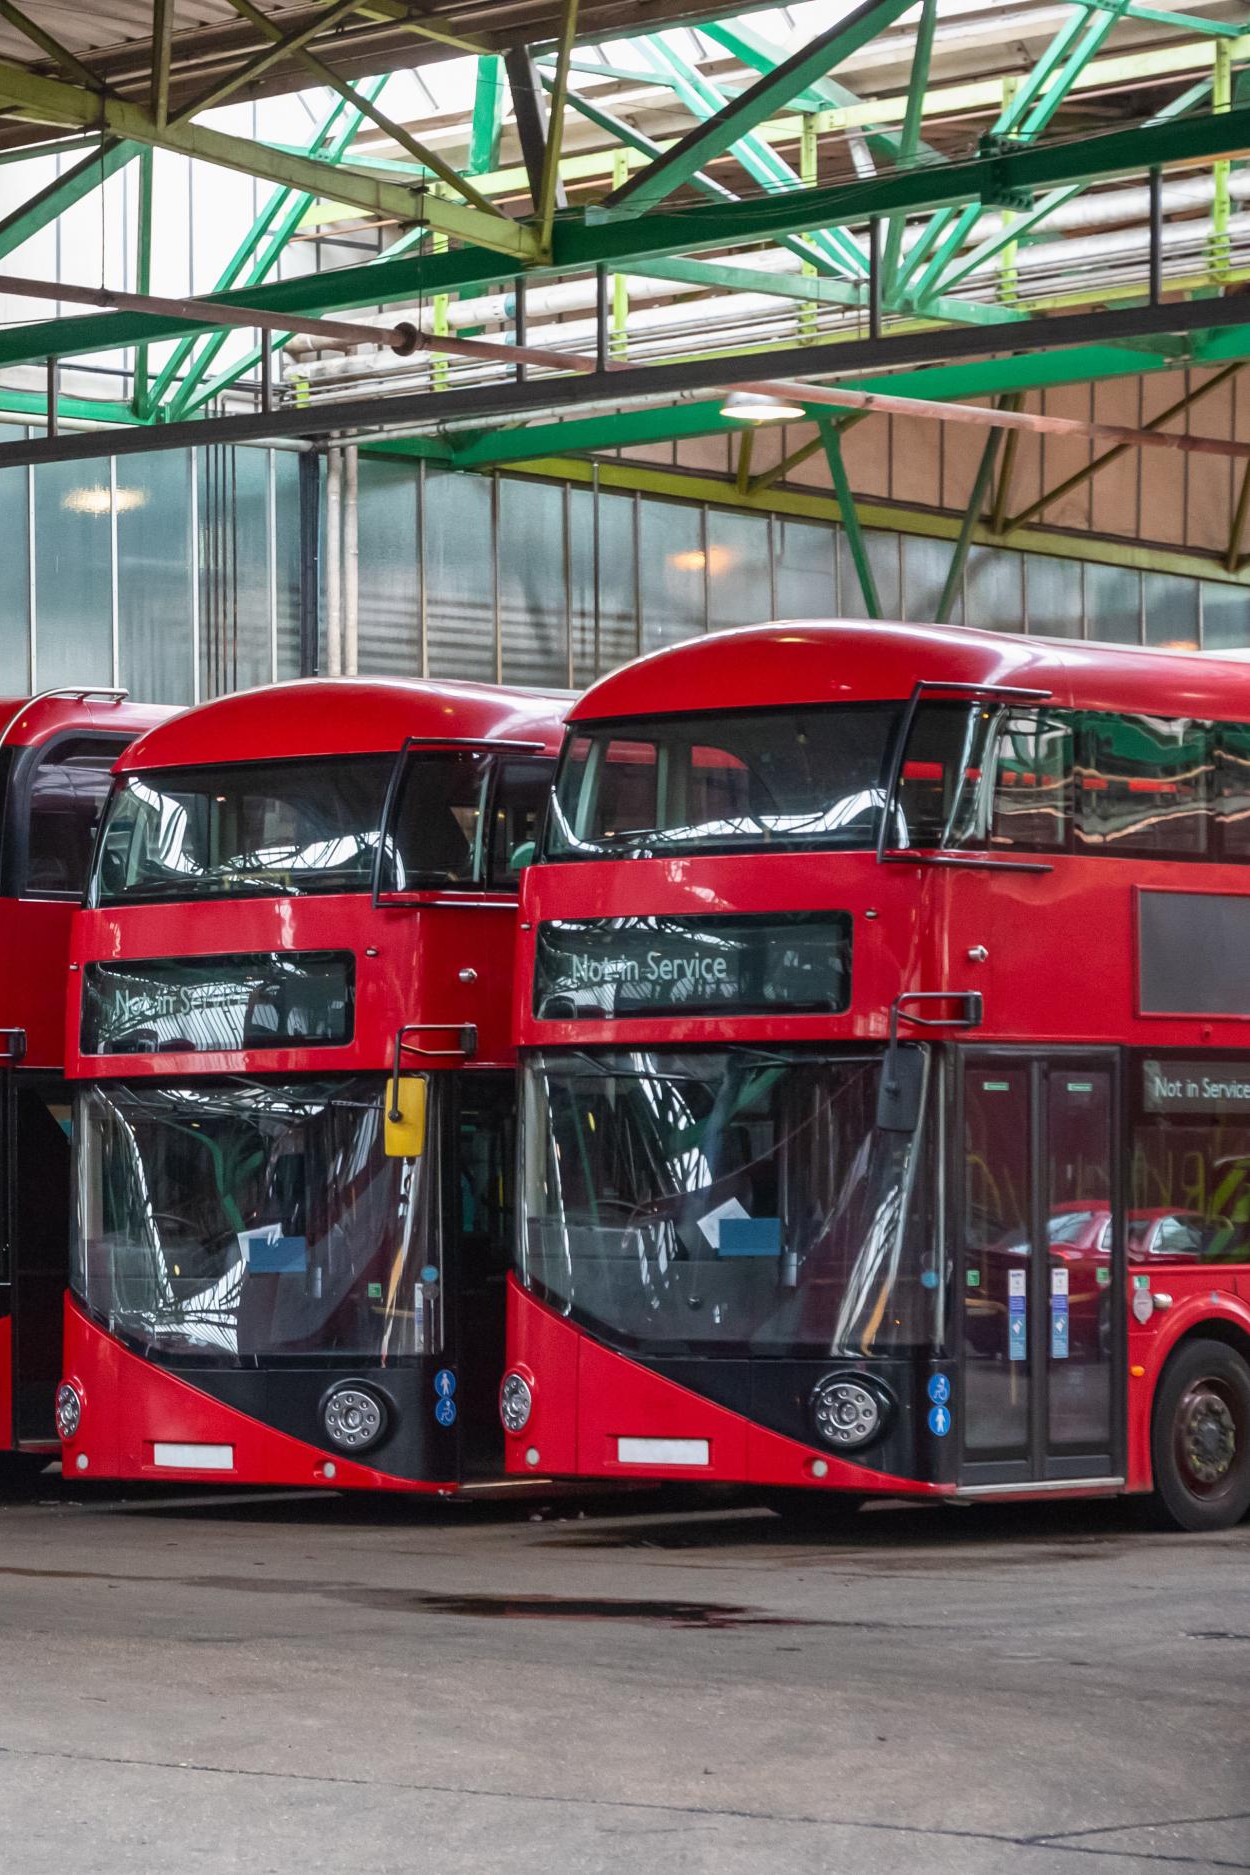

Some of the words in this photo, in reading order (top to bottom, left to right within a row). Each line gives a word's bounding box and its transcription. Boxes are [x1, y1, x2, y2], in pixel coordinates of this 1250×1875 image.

[572, 953, 614, 982] Not
[619, 954, 639, 981] in
[646, 951, 727, 979] Service
[115, 989, 153, 1022] Not
[1154, 1076, 1182, 1098] Not
[1186, 1079, 1199, 1098] in
[1202, 1077, 1250, 1098] Service
